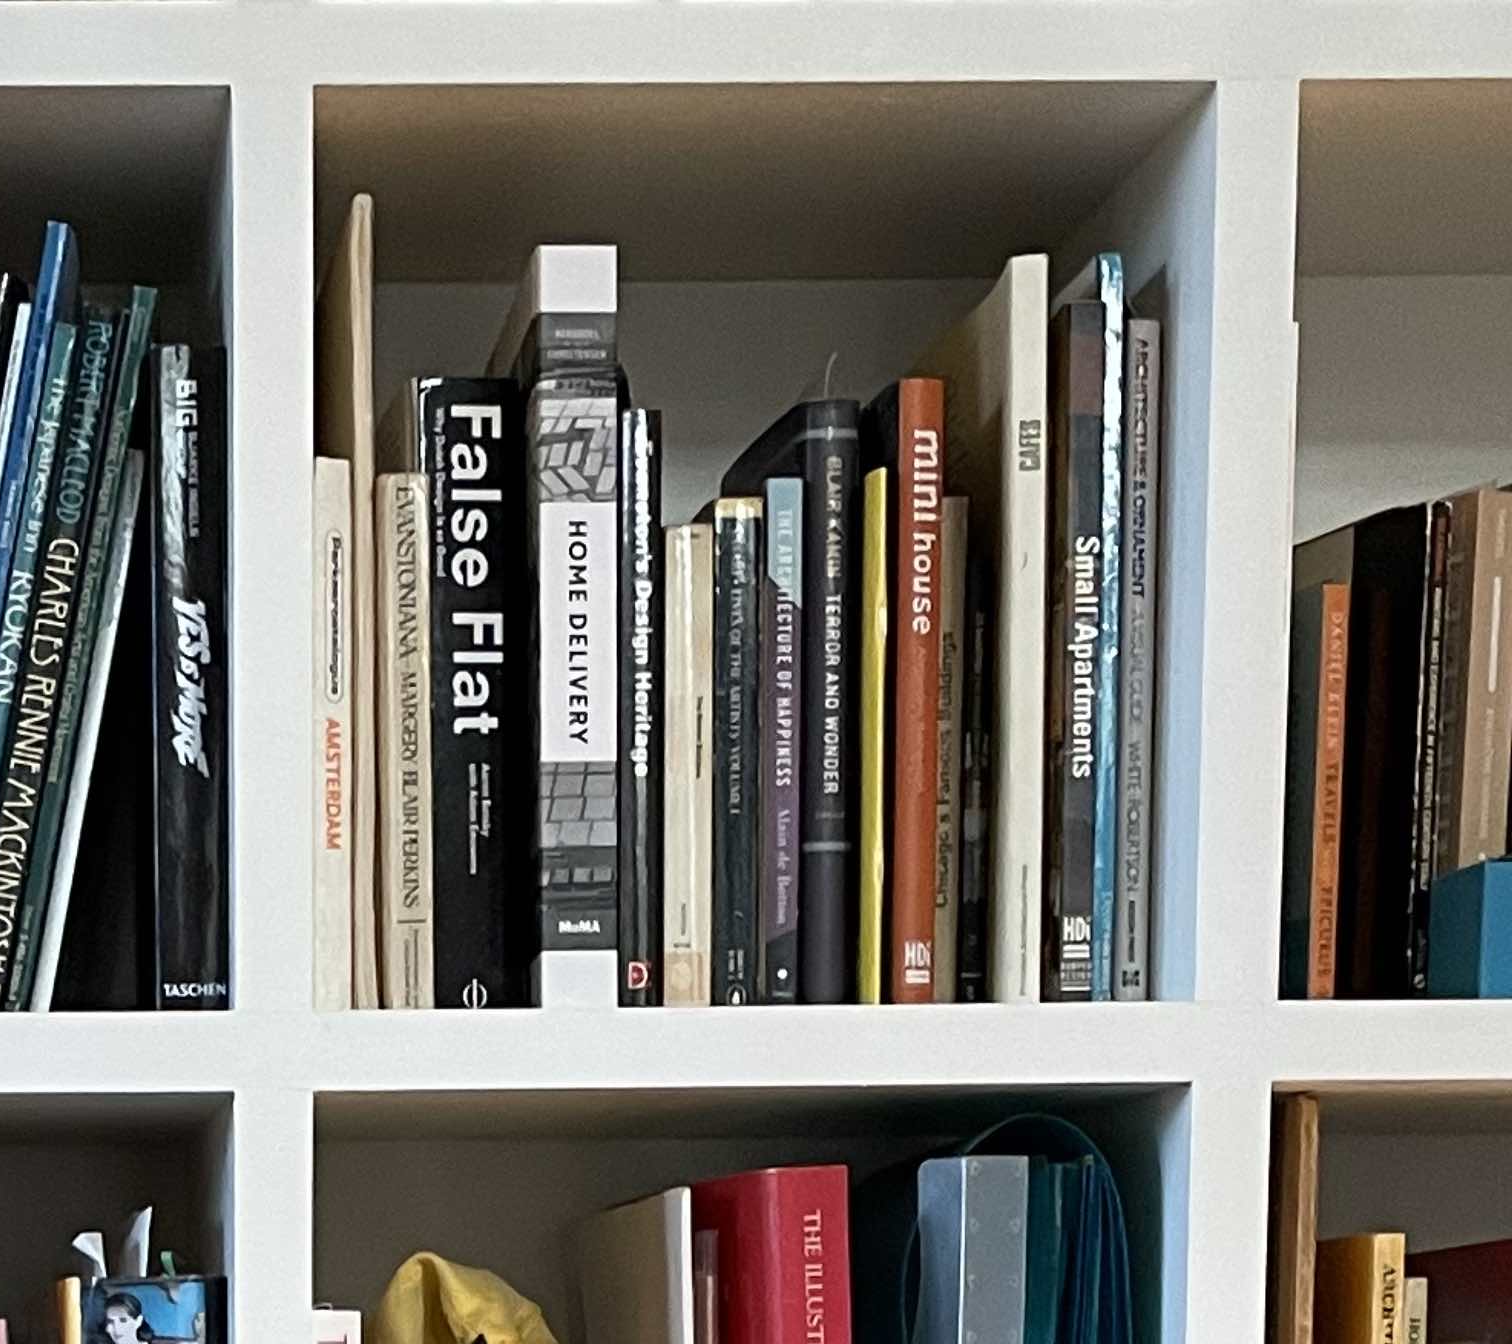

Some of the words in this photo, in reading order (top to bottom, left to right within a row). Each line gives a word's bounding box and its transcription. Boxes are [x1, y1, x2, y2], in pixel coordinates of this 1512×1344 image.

[175, 379, 198, 427] BIG
[450, 405, 503, 587] False
[826, 456, 842, 511] BLAIR
[913, 430, 939, 522] mini
[31, 538, 79, 665] CHARLES
[396, 487, 417, 658] EVANSTONIANA
[568, 520, 588, 608] HOME
[776, 544, 793, 663] ARCHITECTURE
[912, 532, 936, 634] house
[1075, 536, 1099, 613] Small
[174, 597, 211, 664] YES
[631, 580, 651, 663] Design
[825, 593, 842, 666] TERROR
[451, 611, 503, 734] Flat
[568, 613, 588, 746] DELIVERY
[777, 671, 792, 688] OF
[825, 672, 841, 707] AND
[1067, 623, 1098, 778] Apartments
[10, 674, 53, 772] RENNIE
[170, 671, 210, 777] MORE
[400, 672, 418, 763] MARGERY
[629, 672, 651, 778] Heritage
[776, 697, 792, 786] HAPPINESS
[824, 716, 840, 794] WONDER
[326, 718, 341, 849] AMSTERDAM
[777, 809, 790, 846] Alain
[402, 830, 420, 908] PERKINS
[777, 852, 789, 869] de
[163, 982, 227, 998] TASCHEN
[803, 1209, 822, 1256] THE
